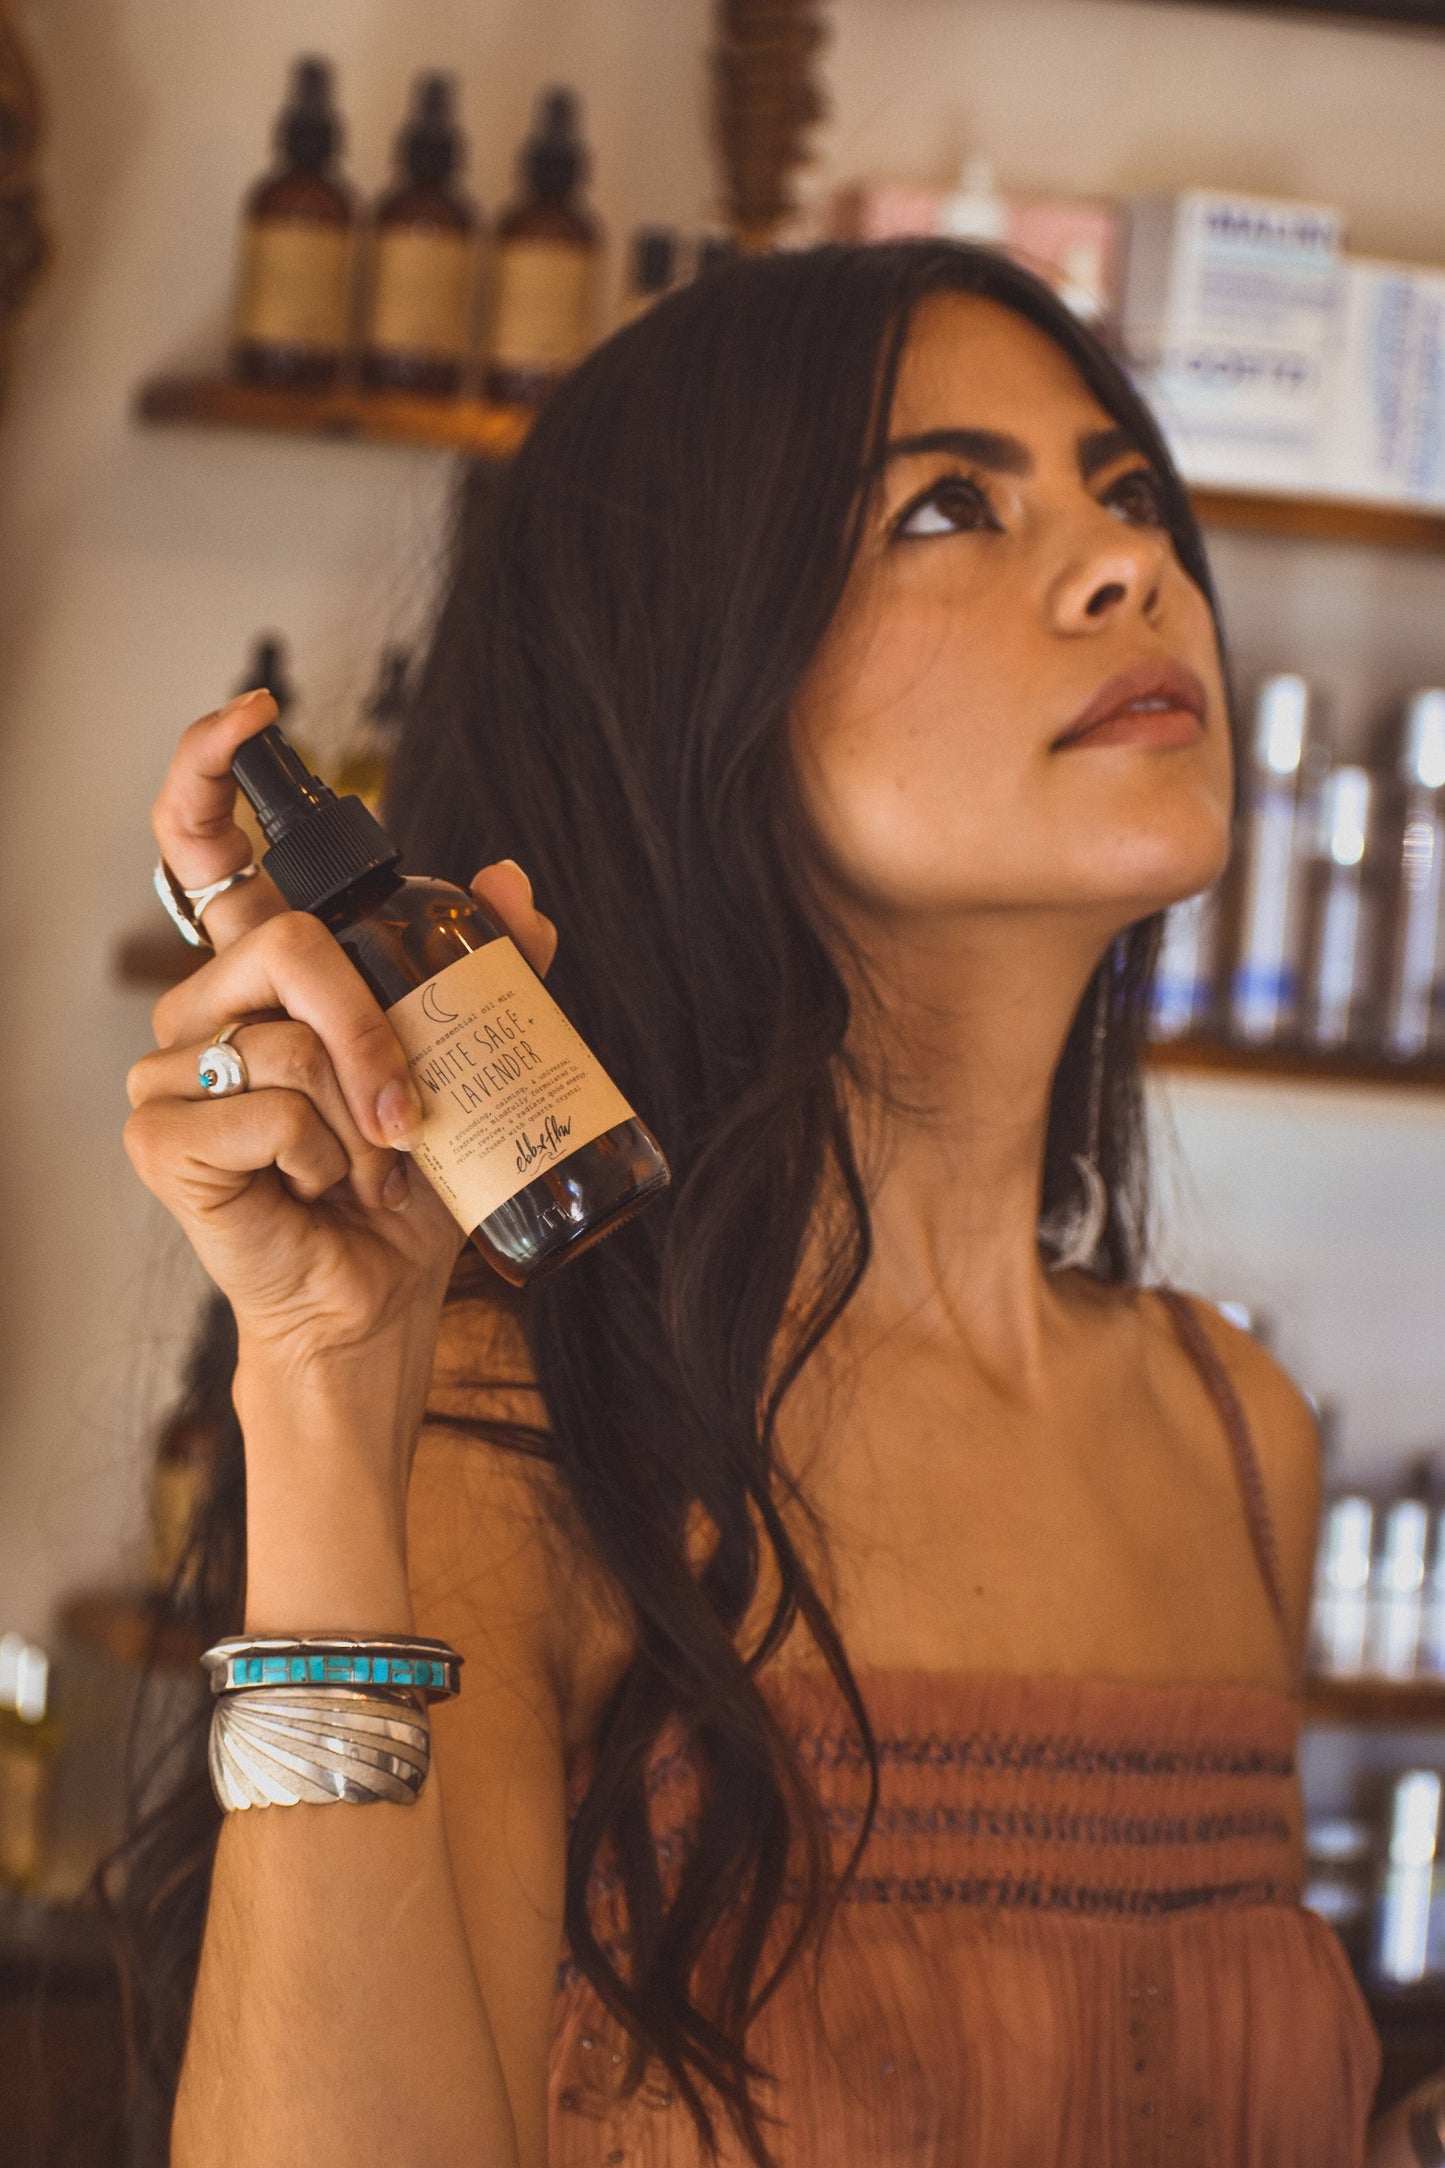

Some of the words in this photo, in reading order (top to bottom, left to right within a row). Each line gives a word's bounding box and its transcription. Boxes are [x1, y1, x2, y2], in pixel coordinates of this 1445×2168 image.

[406, 1044, 433, 1068] rganic
[433, 1012, 477, 1046] essential
[480, 1000, 495, 1014] oil
[496, 988, 515, 1004] mist
[419, 1043, 475, 1095] WHITE
[475, 1009, 525, 1054] SAGE
[452, 1040, 541, 1114] LAVENDER
[489, 1094, 529, 1125] mindfully
[530, 1069, 569, 1097] formulated
[568, 1063, 577, 1072] to
[494, 1084, 528, 1110] calming,
[537, 1056, 570, 1080] universal
[515, 1095, 546, 1118] radiate
[546, 1082, 565, 1098] good
[477, 1134, 506, 1158] infused
[506, 1120, 526, 1137] with
[527, 1102, 553, 1123] quartz
[554, 1084, 581, 1104] crystal
